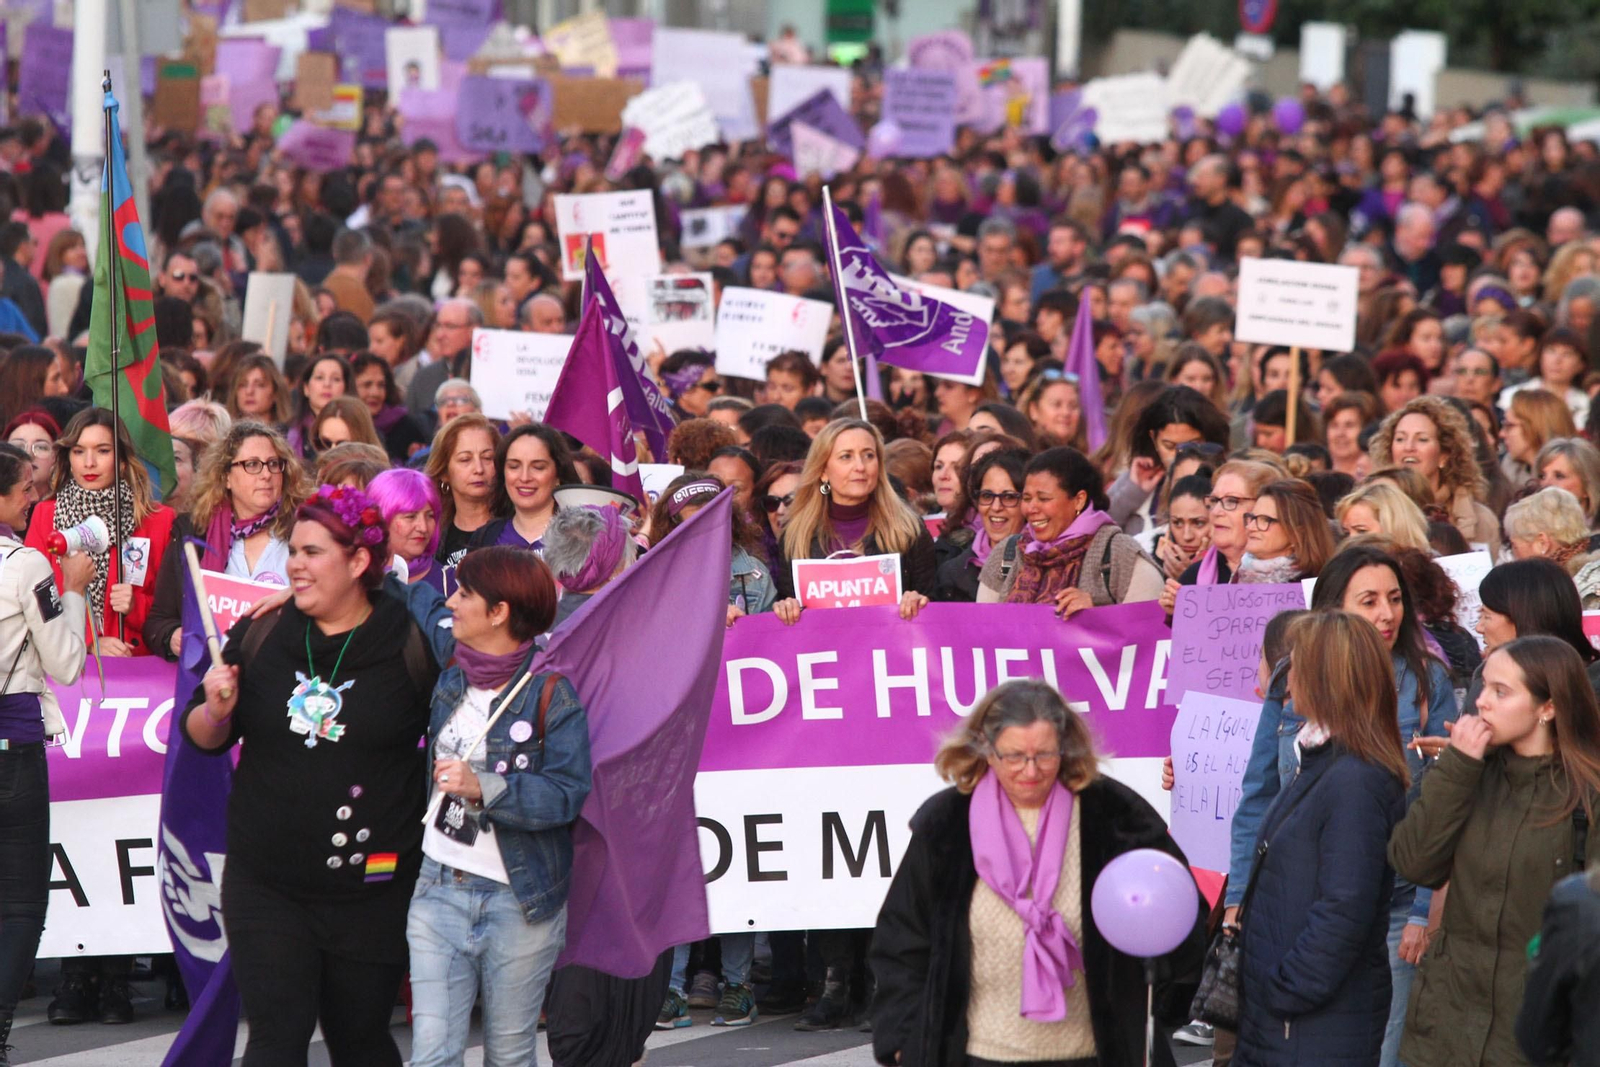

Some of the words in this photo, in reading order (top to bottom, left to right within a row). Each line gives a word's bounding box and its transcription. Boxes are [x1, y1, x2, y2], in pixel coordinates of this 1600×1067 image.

[806, 577, 889, 600] APUNTA
[1222, 589, 1306, 611] NOSOTRAS
[1182, 646, 1208, 664] EL
[726, 650, 843, 726] DE
[1188, 715, 1210, 740] LA
[696, 813, 788, 885] DE
